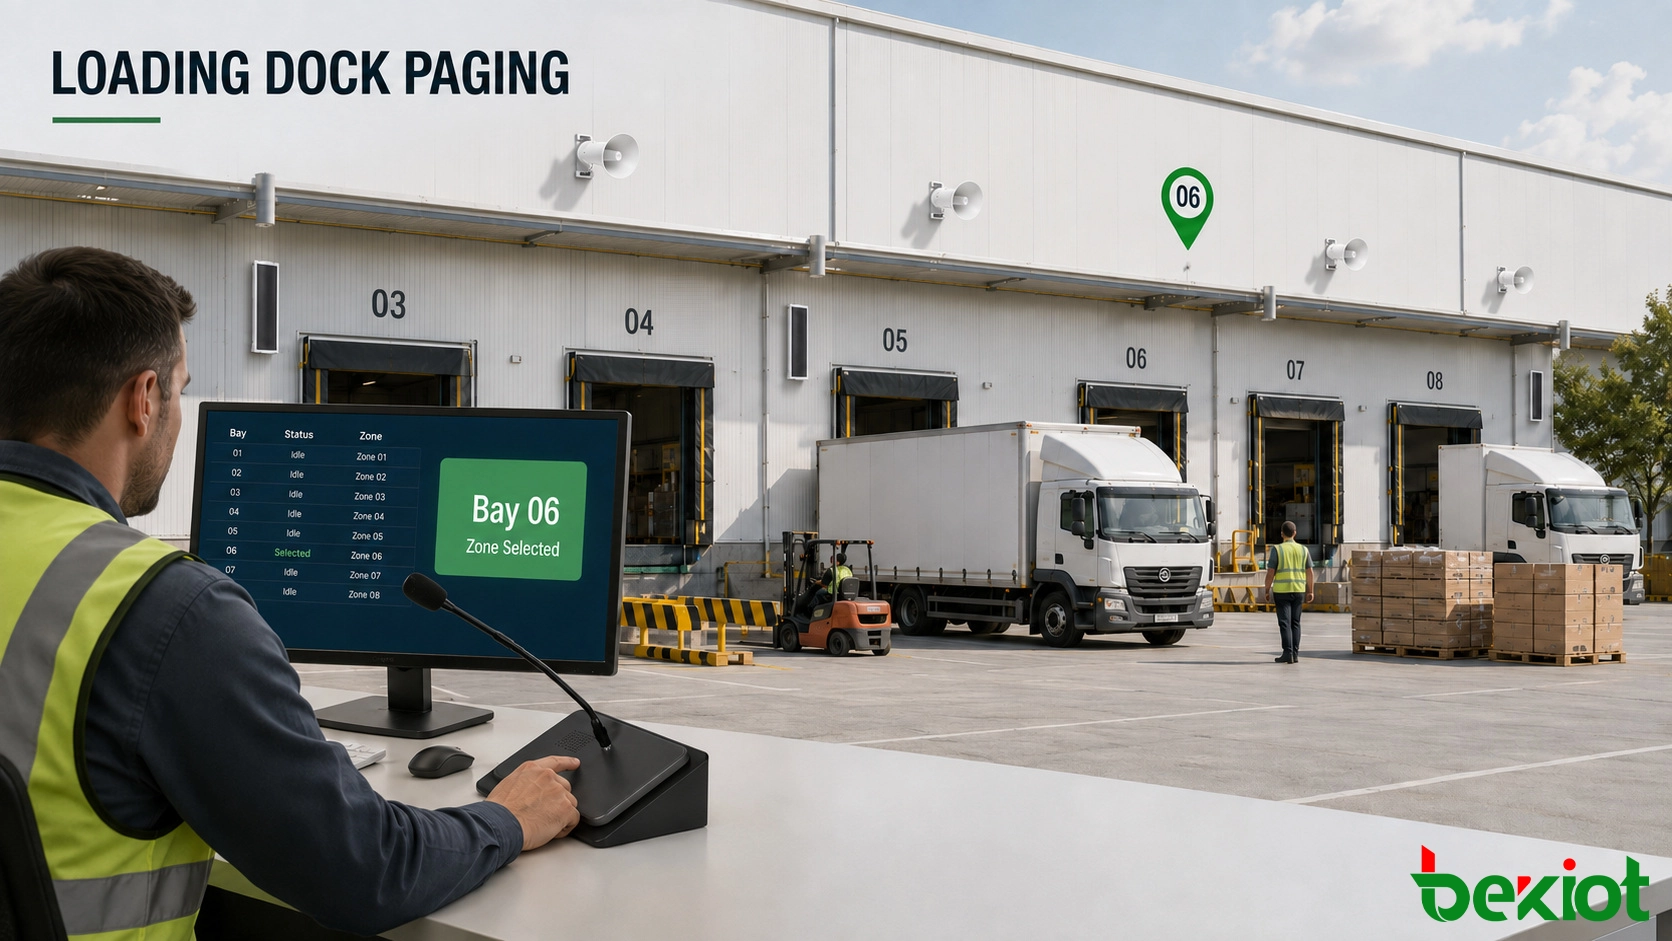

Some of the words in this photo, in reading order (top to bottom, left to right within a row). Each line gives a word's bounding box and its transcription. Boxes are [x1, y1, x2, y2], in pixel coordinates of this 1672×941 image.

[371, 289, 406, 320] 03
[624, 308, 654, 336] 04
[882, 328, 908, 353] 05
[1126, 347, 1147, 369] 06
[1286, 360, 1305, 381] 07
[1426, 371, 1444, 391] 08
[230, 429, 247, 439] Bay
[284, 430, 314, 439] Status
[359, 432, 382, 441] Zone
[291, 451, 305, 459] Idle
[356, 453, 376, 461] Zone
[377, 453, 387, 461] 01
[231, 469, 241, 477] 02
[290, 471, 304, 479] Idle
[355, 473, 374, 481] Zone
[376, 473, 386, 481] 02
[354, 492, 373, 501] Zone
[375, 493, 385, 501] 03
[288, 510, 302, 518] Idle
[353, 512, 372, 520] Zone
[374, 513, 384, 521] 04
[472, 494, 520, 531] Bay
[528, 496, 560, 526] 06
[227, 527, 238, 535] 05
[286, 529, 301, 538] Idle
[352, 532, 371, 540] Zone
[373, 533, 383, 541] 05
[226, 547, 237, 555] 06
[466, 538, 499, 555] Zone
[503, 540, 560, 557] Selected
[274, 548, 311, 558] Selected
[351, 552, 370, 560] Zone
[225, 566, 235, 574] 07
[284, 568, 298, 577] Idle
[350, 571, 369, 580] Zone
[371, 572, 381, 580] 07
[283, 588, 297, 596] Idle
[349, 591, 367, 599] Zone
[370, 591, 380, 599] 08
